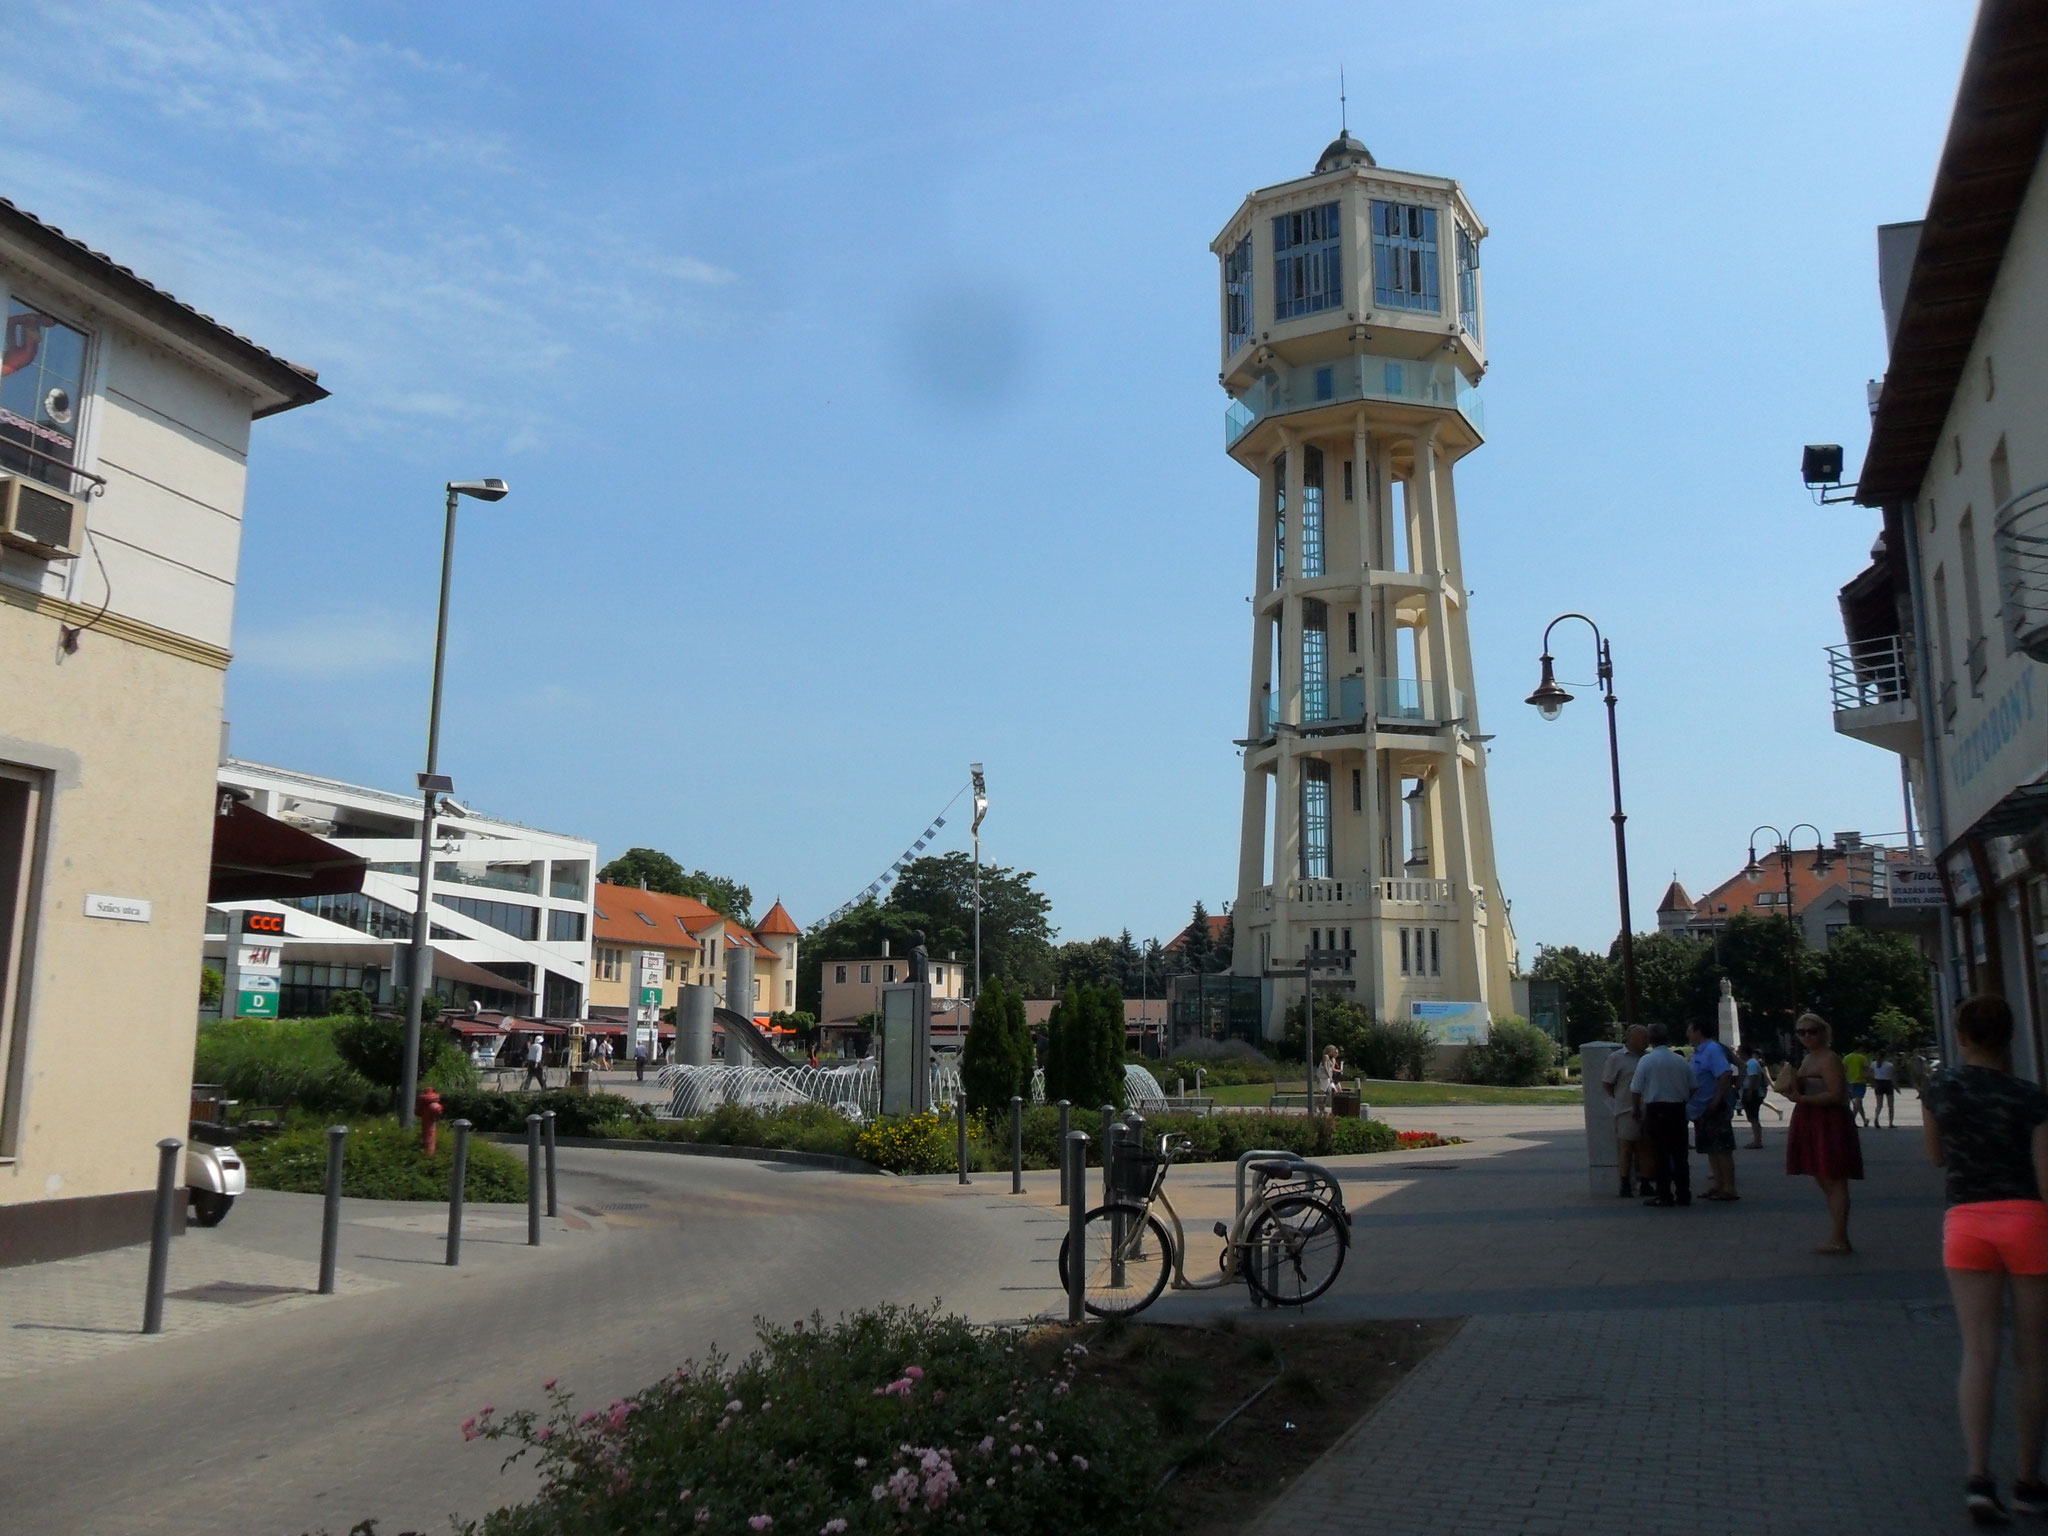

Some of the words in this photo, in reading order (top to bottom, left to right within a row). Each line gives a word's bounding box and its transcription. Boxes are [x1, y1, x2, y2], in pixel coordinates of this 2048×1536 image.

[123, 906, 140, 915] utca
[249, 915, 281, 931] CCC
[253, 995, 264, 1007] D
